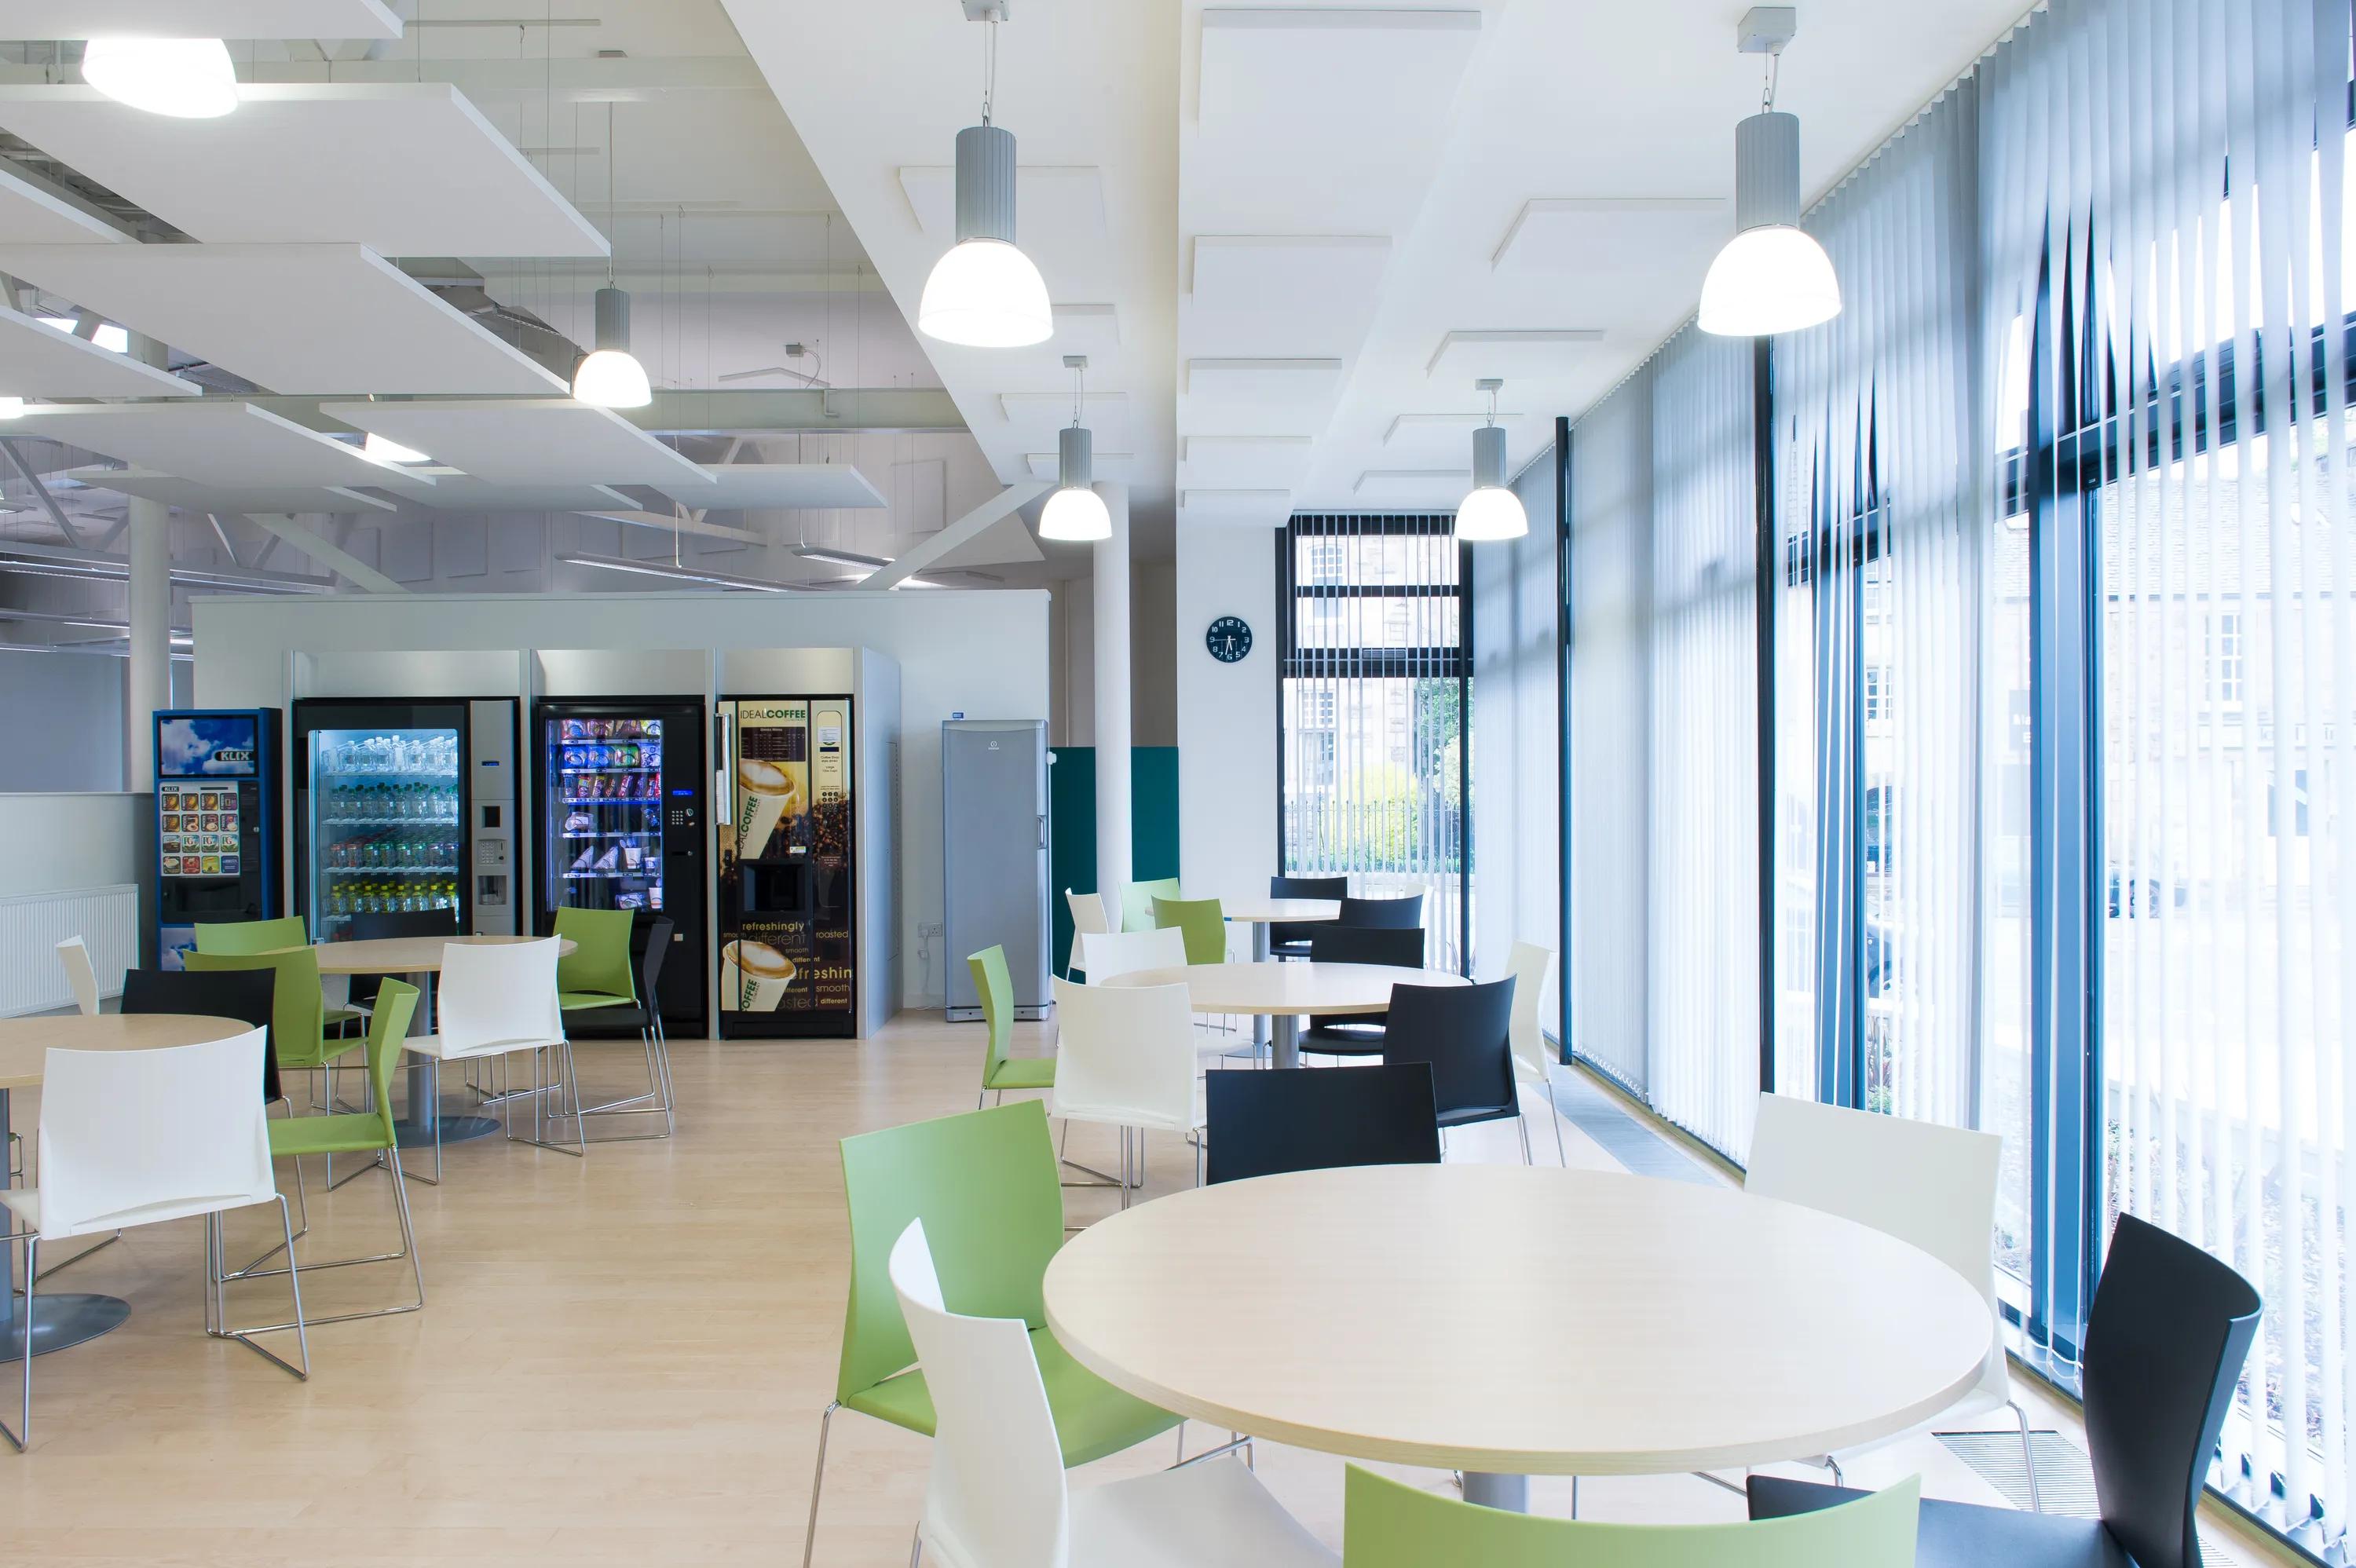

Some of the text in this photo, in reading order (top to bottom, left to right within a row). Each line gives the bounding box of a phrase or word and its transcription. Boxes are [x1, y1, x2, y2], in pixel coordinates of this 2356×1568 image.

[221, 751, 250, 761] KLIX
[742, 921, 805, 932] refreshingly
[816, 930, 849, 939] roasted
[816, 983, 851, 992] smooth
